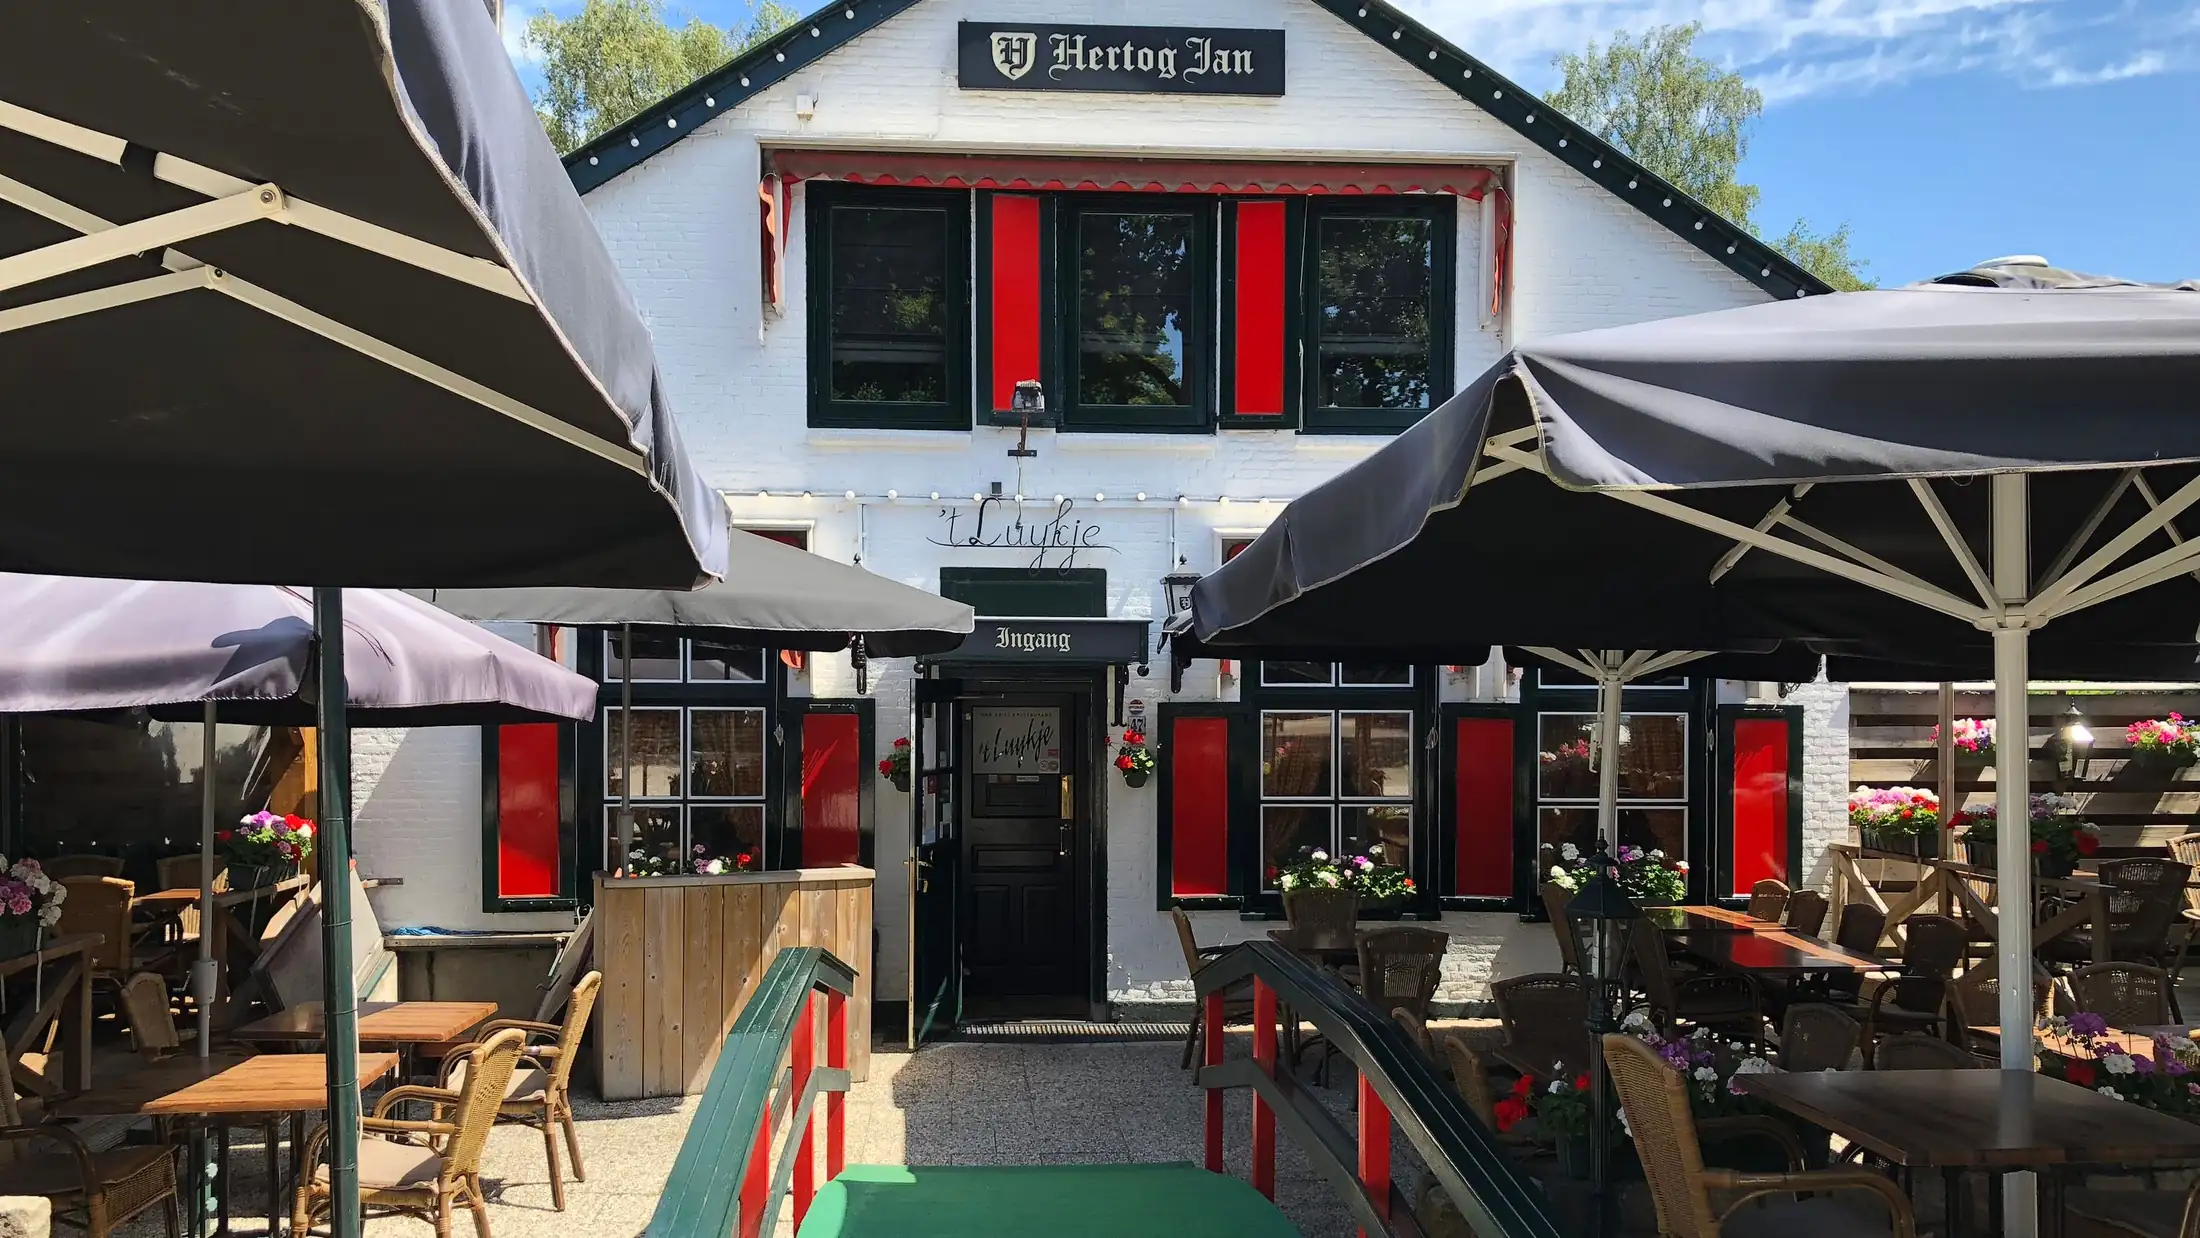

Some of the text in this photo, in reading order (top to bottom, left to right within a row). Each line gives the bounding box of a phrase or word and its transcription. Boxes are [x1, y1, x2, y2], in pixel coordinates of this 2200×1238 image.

[1048, 33, 1254, 84] Hertog Jan
[968, 497, 1101, 576] Luykje
[995, 627, 1071, 652] Ingang
[1131, 718, 1144, 732] 47
